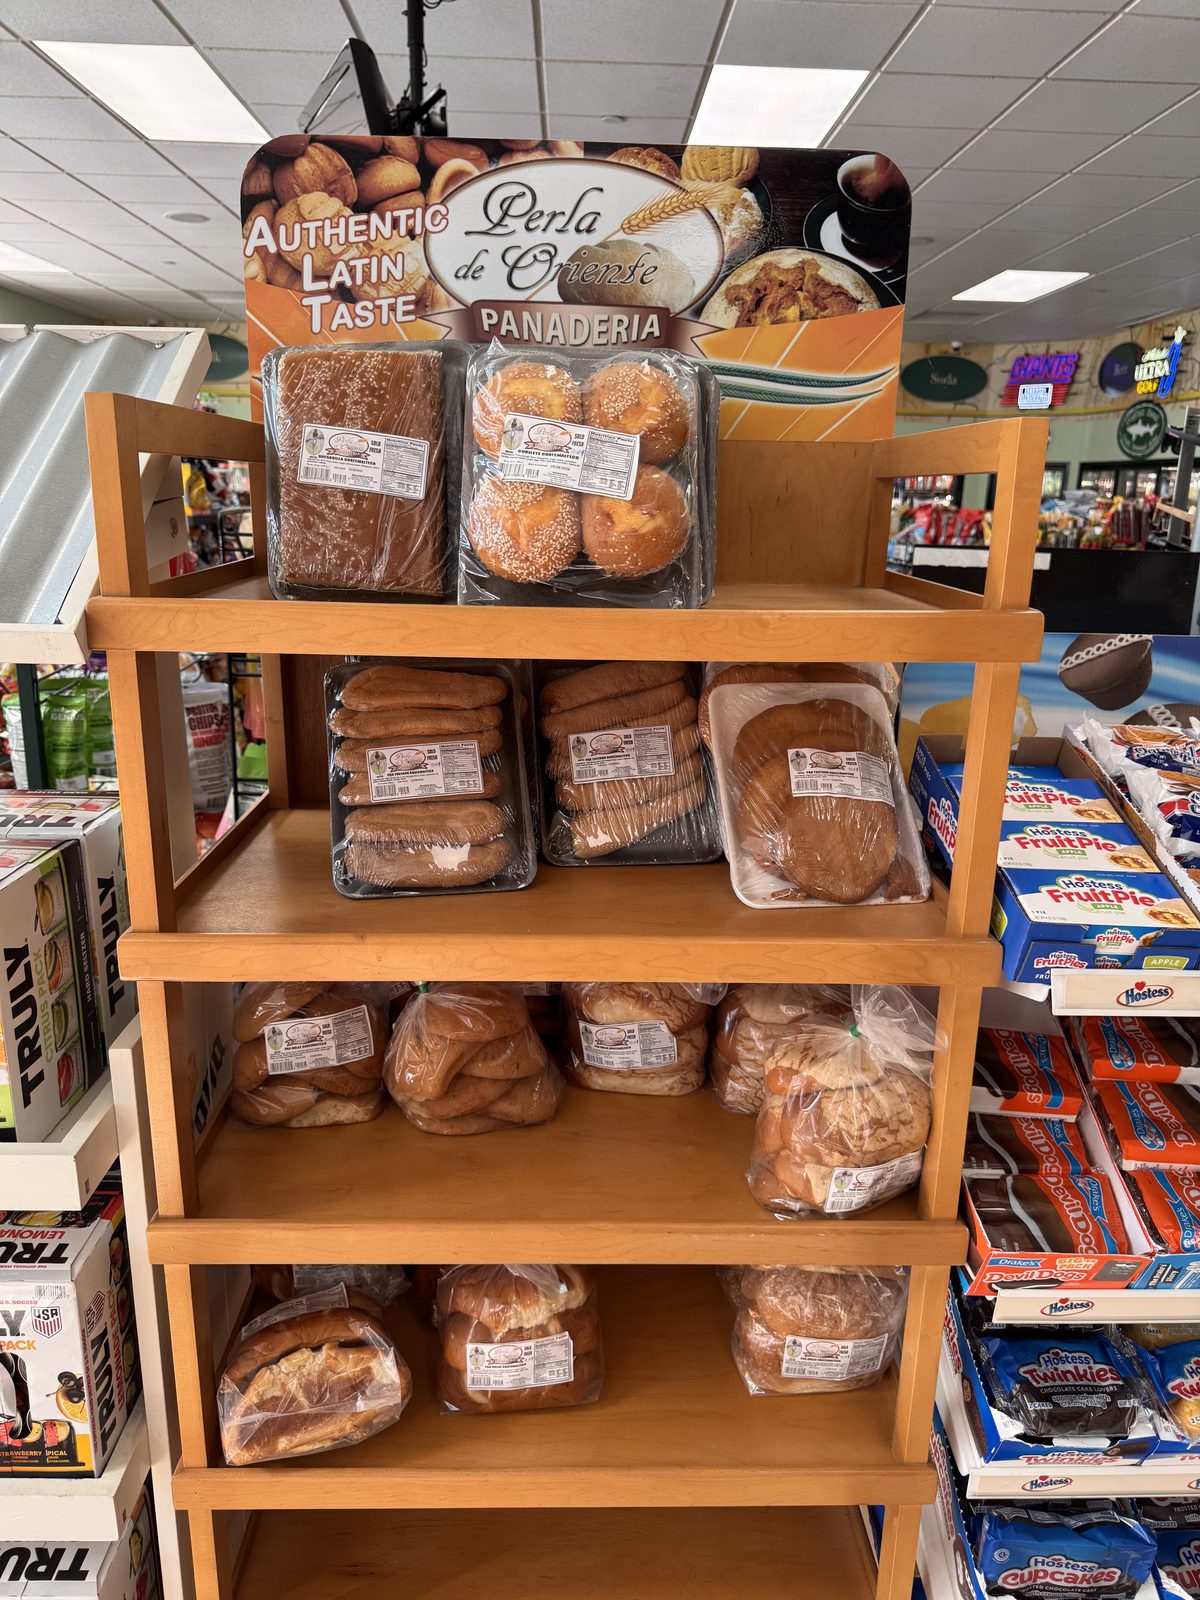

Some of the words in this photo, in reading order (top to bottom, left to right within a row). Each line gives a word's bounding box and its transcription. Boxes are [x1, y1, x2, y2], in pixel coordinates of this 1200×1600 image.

[464, 181, 604, 236] Perla
[243, 202, 450, 258] AUTHENTIC
[300, 251, 405, 293] LATIN
[454, 249, 489, 280] de
[501, 242, 658, 291] Oriente
[300, 293, 417, 334] TASTE
[480, 307, 661, 346] PANADERIA
[1010, 353, 1079, 379] GIANTS
[1135, 360, 1170, 381] ULTRA
[929, 371, 958, 386] Soda
[186, 703, 218, 716] PROTEIN
[188, 714, 224, 730] CHIPS
[1004, 792, 1081, 806] ruitPie
[1028, 828, 1088, 837] Hostess
[1062, 879, 1123, 890] Hostess
[33, 948, 48, 999] PACK
[1125, 988, 1170, 1005] Hostess
[3, 943, 45, 1109] TRULY
[39, 1000, 55, 1063] CITRUS
[1089, 1177, 1100, 1212] Drake's
[1176, 1206, 1193, 1238] Drake's
[0, 1229, 66, 1240] LEMONA
[1070, 1211, 1099, 1254] Dog
[0, 1241, 70, 1264] TRU
[998, 1258, 1037, 1266] Drake's
[1056, 1257, 1082, 1265] BIG
[33, 1306, 59, 1320] USA
[1049, 1302, 1092, 1313] Hostess
[1042, 1352, 1092, 1368] Hostess
[112, 1331, 125, 1411] LEMONADE
[1022, 1365, 1122, 1385] Twinkies
[90, 1326, 117, 1457] TRULY
[1040, 1386, 1076, 1394] CHOCOLATE
[1024, 1456, 1120, 1464] Twinkies
[1029, 1477, 1069, 1489] Hostess
[1173, 1504, 1198, 1513] FROSTED
[0, 1546, 90, 1582] TRU
[1034, 1557, 1096, 1573] Hostess
[1002, 1568, 1118, 1587] Cupcakes
[1045, 1585, 1081, 1593] CHOCOLATE
